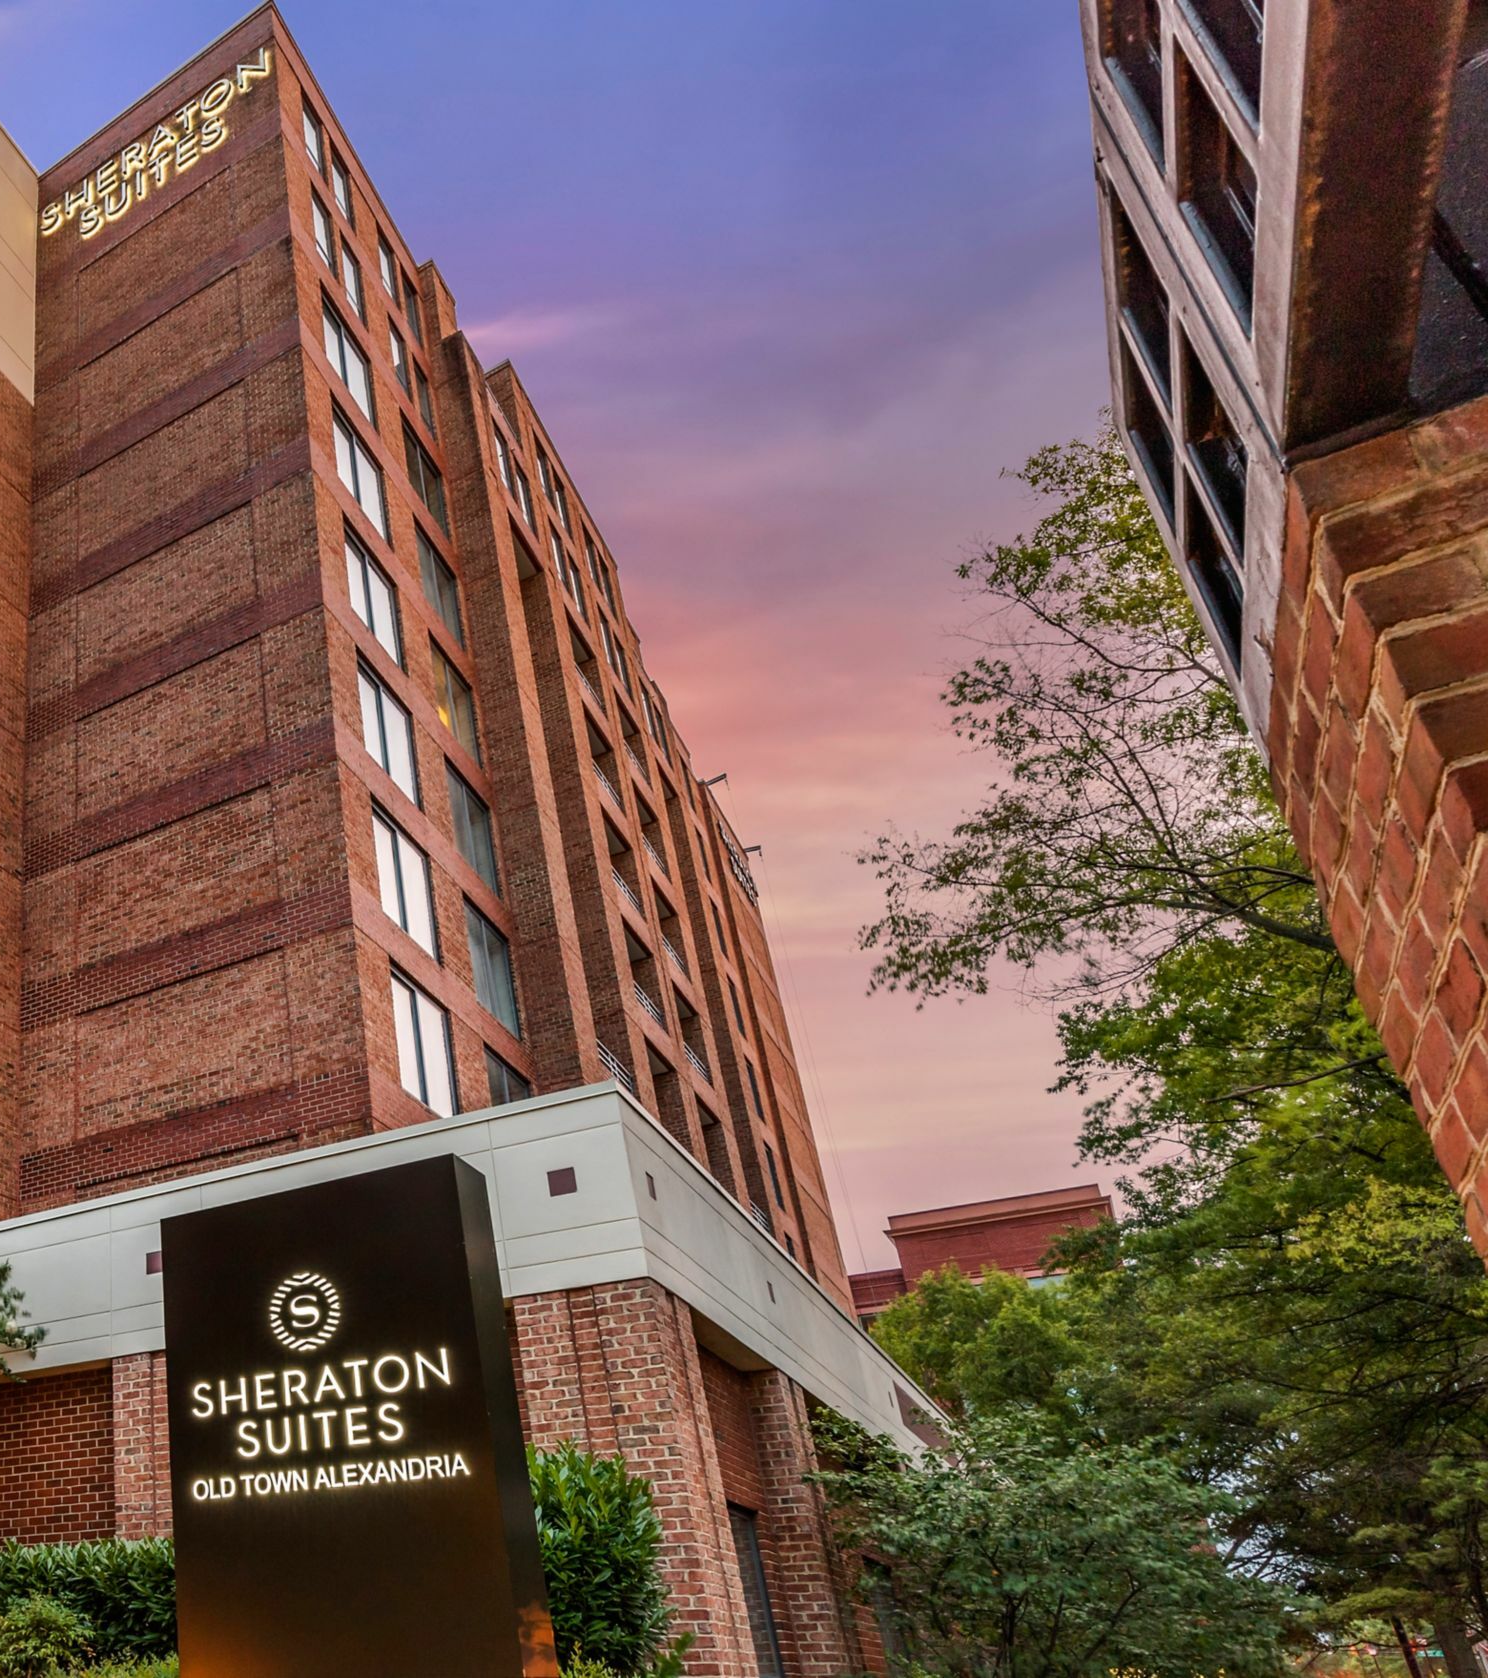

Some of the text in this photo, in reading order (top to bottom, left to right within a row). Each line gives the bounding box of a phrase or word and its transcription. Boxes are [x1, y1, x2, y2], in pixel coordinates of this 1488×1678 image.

[40, 48, 270, 235] SHERATON
[79, 116, 228, 239] SUITES
[289, 1294, 320, 1328] S
[191, 1347, 452, 1418] SHERATON
[236, 1402, 405, 1458] SUITES
[192, 1453, 471, 1501] OLD TOWN ALEXANDRIA
